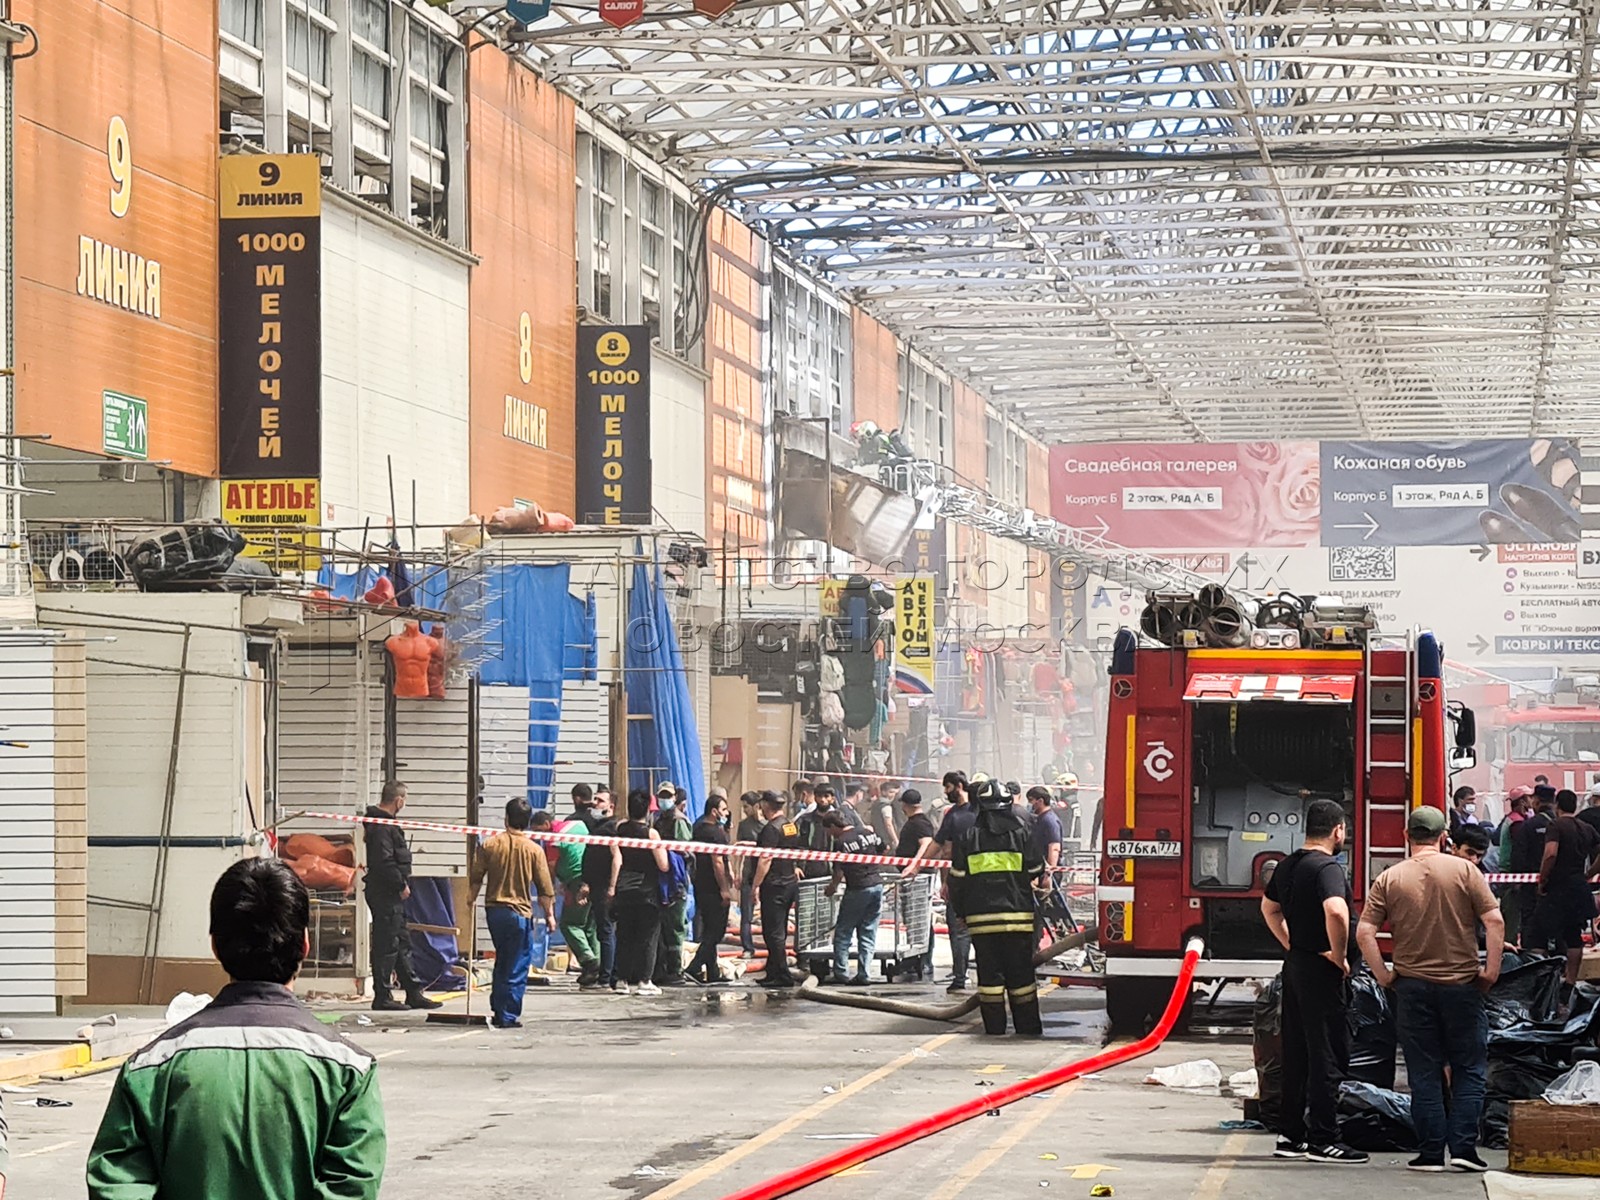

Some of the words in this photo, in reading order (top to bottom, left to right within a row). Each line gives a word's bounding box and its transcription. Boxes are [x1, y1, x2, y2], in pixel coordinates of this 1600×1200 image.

[107, 115, 132, 218] 9
[258, 162, 281, 186] 9
[237, 192, 303, 206] ЛИНИЯ
[238, 233, 305, 252] 1000
[76, 234, 161, 318] ЛИНИЯ
[519, 311, 532, 384] 8
[607, 338, 618, 351] 8
[255, 264, 286, 458] МЕЛОЧЕЙ
[587, 369, 640, 384] 1000
[503, 394, 548, 450] ЛИНИЯ
[1065, 456, 1162, 474] Свадебная
[1167, 460, 1238, 475] галерея
[1333, 455, 1411, 470] Кожаная
[1414, 454, 1467, 472] обувь
[226, 483, 316, 509] АТЕЛЬЕ
[1065, 494, 1107, 506] Корпус
[1109, 493, 1118, 504] Б
[1127, 493, 1135, 503] 2
[1170, 493, 1192, 504] Ряд
[1333, 491, 1377, 503] Корпус
[1379, 490, 1388, 501] Б
[1397, 491, 1402, 501] 1
[1439, 490, 1460, 501] Ряд
[240, 514, 270, 523] РЕМОНТ
[271, 514, 307, 524] ОДЕЖДЫ
[1504, 553, 1549, 561] НАПРОТИВ
[1361, 590, 1401, 599] КАМЕРУ
[1520, 598, 1580, 607] БЕСПЛАТНЫЙ
[902, 582, 914, 642] АВТО
[916, 582, 927, 642] ЧЕХЛЫ
[1502, 640, 1551, 651] КОВРЫ
[1554, 640, 1563, 650] И
